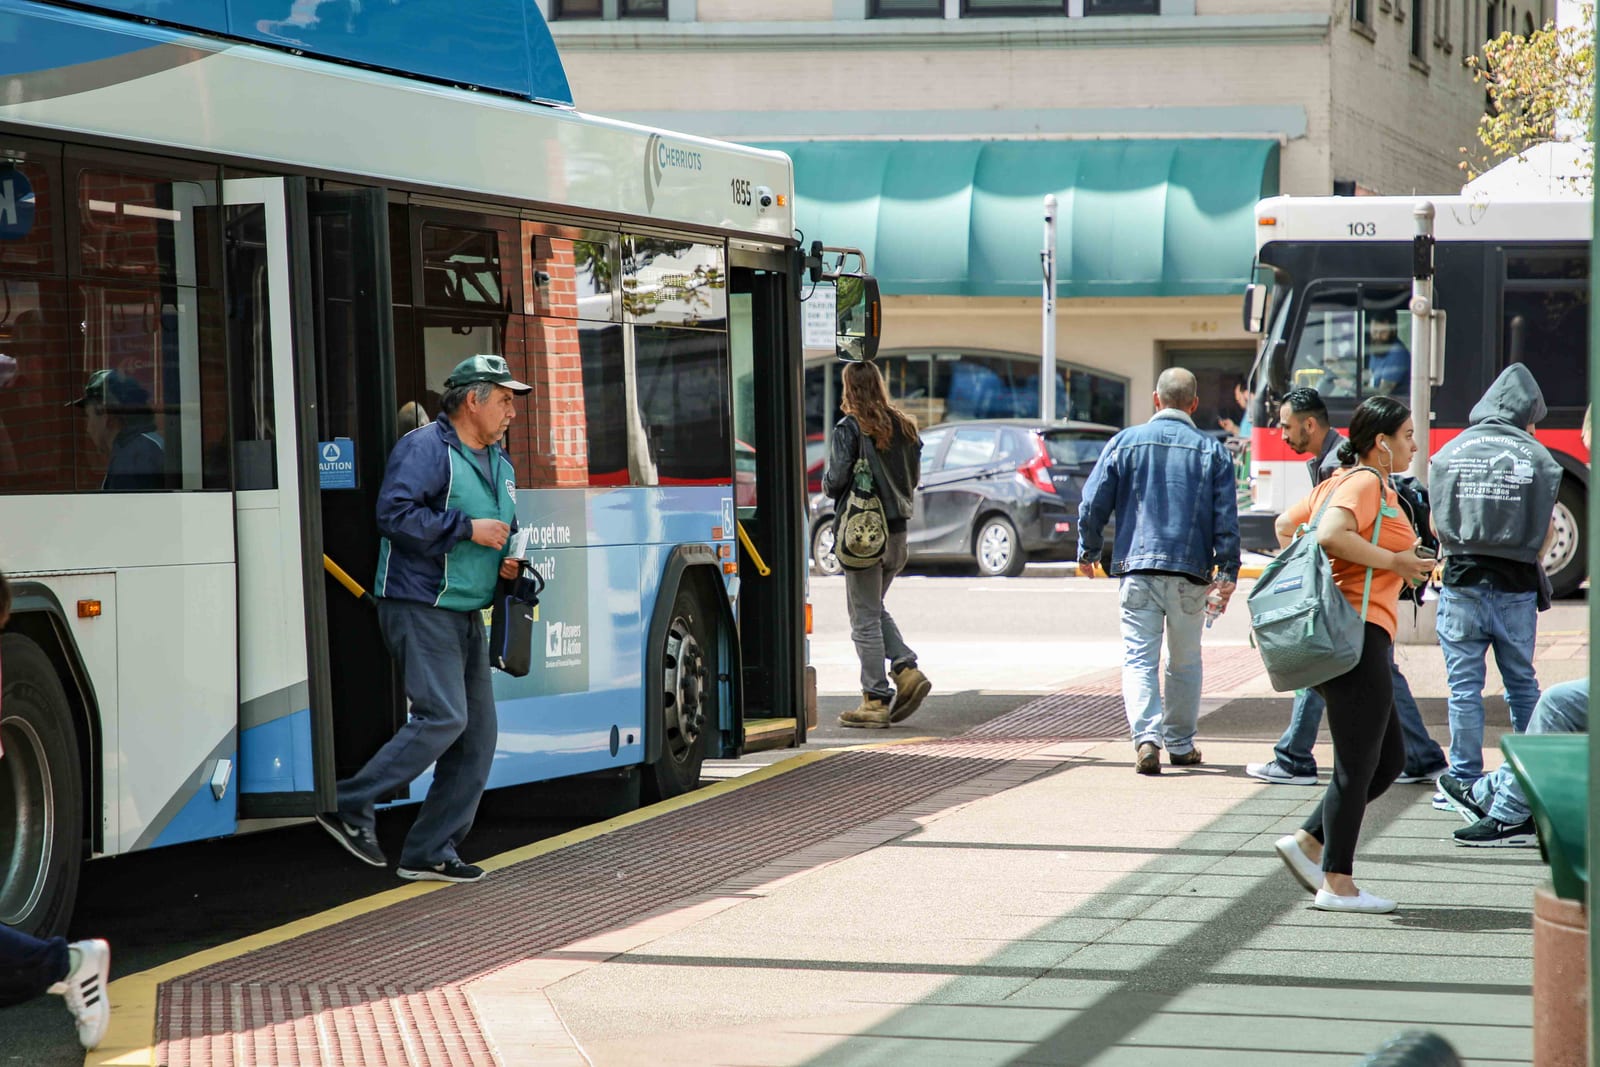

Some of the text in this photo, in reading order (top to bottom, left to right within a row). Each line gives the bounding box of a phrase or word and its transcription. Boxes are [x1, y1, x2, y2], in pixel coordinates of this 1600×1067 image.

[658, 143, 702, 171] CHERRIOTS
[731, 178, 752, 206] 1855
[1347, 222, 1376, 236] 103
[319, 461, 352, 471] AUTION
[529, 522, 540, 545] to
[541, 522, 555, 549] get
[557, 525, 570, 544] me
